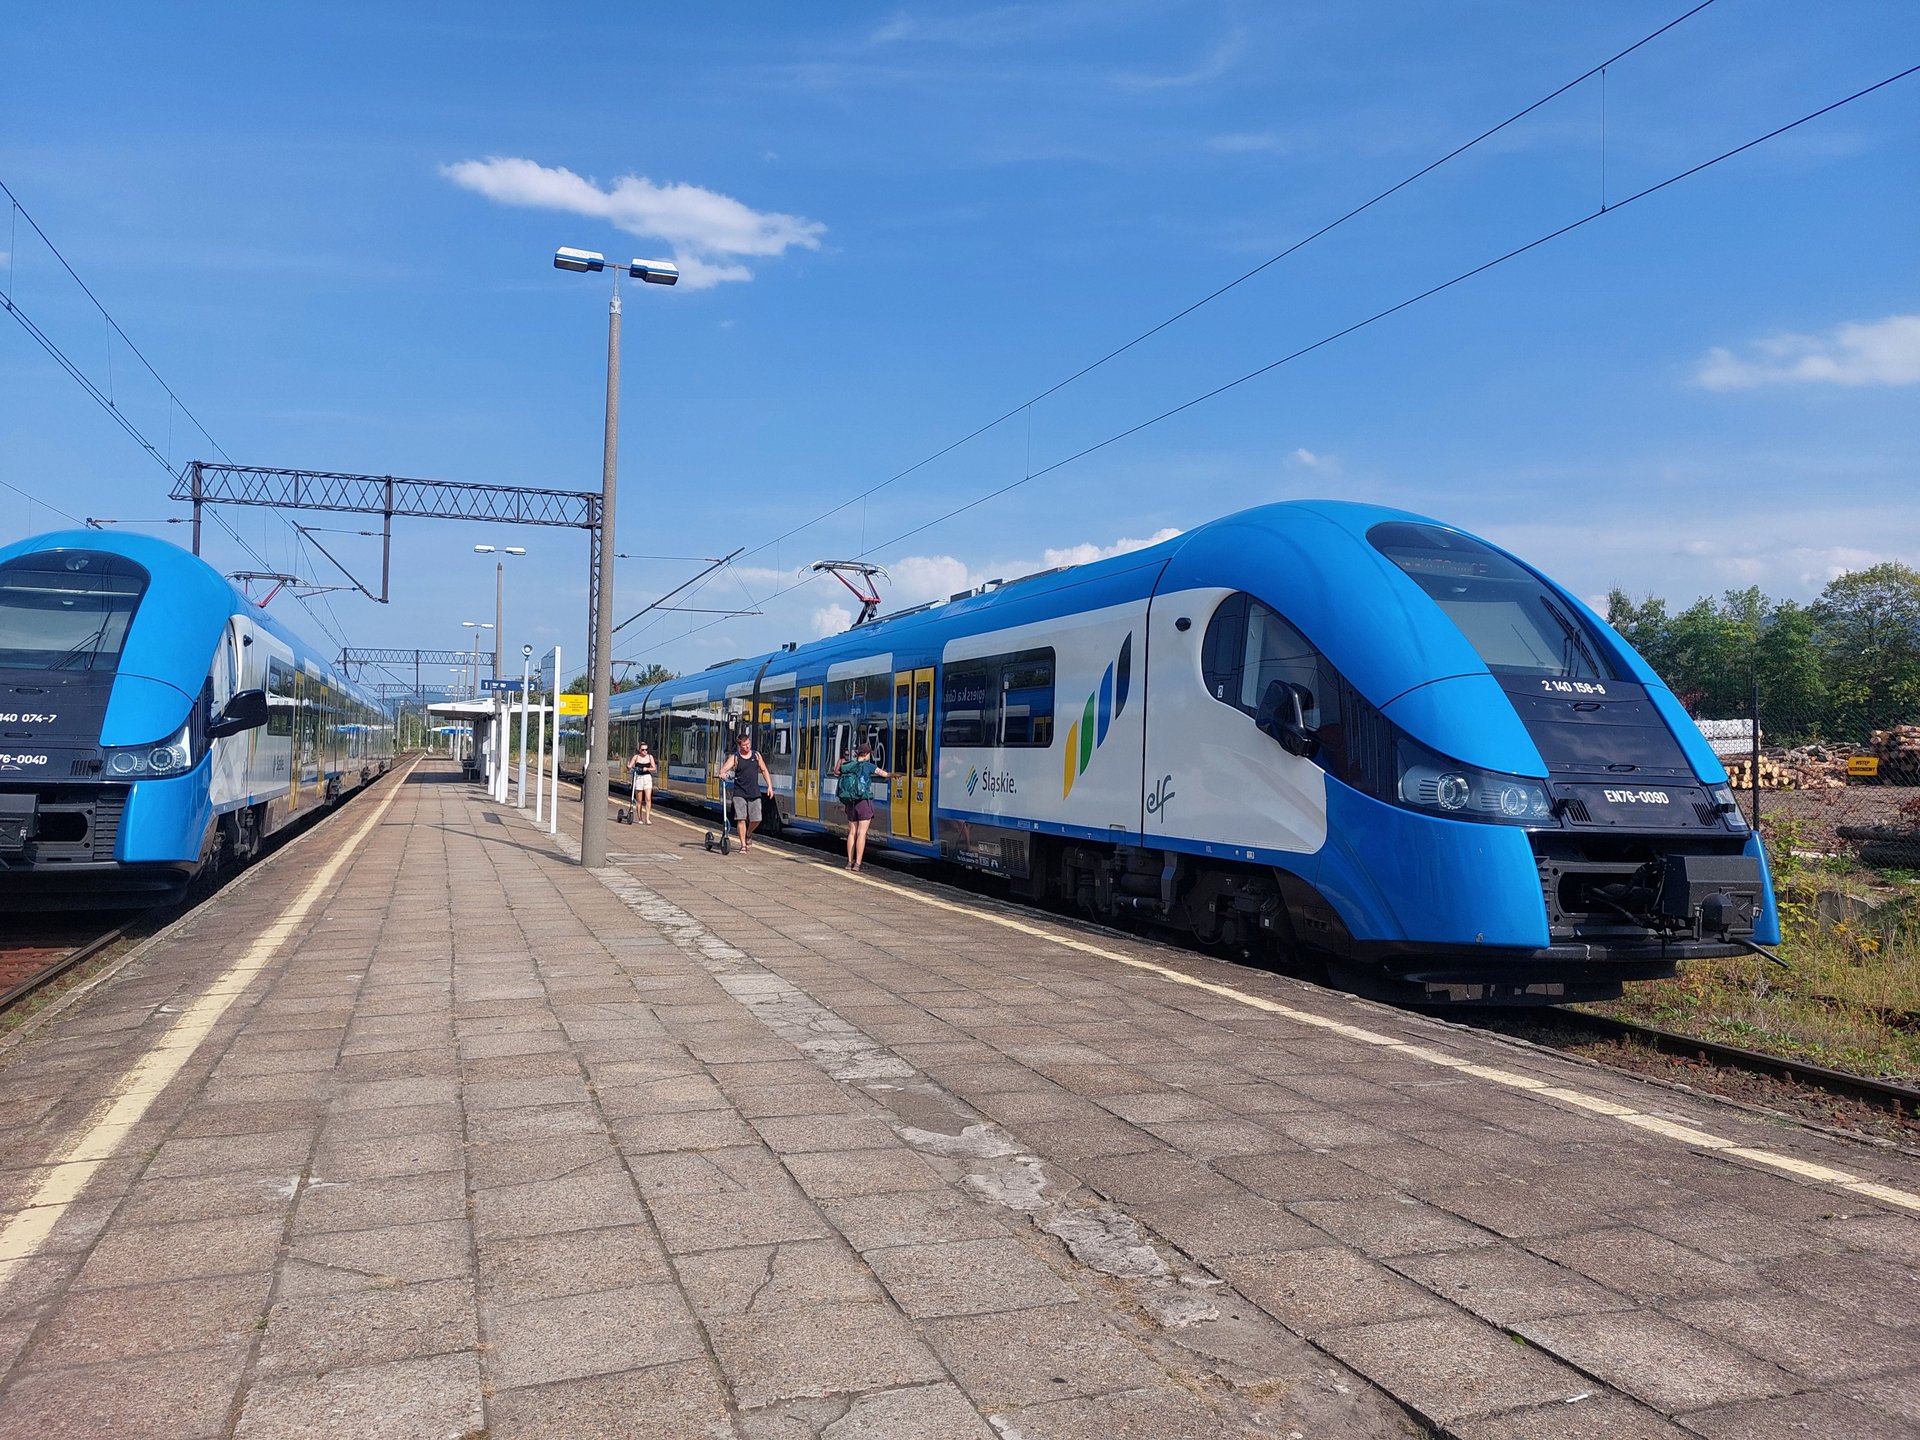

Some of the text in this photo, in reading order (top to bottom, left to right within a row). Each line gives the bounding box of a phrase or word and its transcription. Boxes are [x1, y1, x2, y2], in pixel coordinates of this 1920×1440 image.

[1541, 680, 1606, 695] 2 140 158-8
[21, 713, 57, 723] 074-7
[1146, 774, 1175, 824] elf
[1603, 790, 1669, 804] EN76-009D
